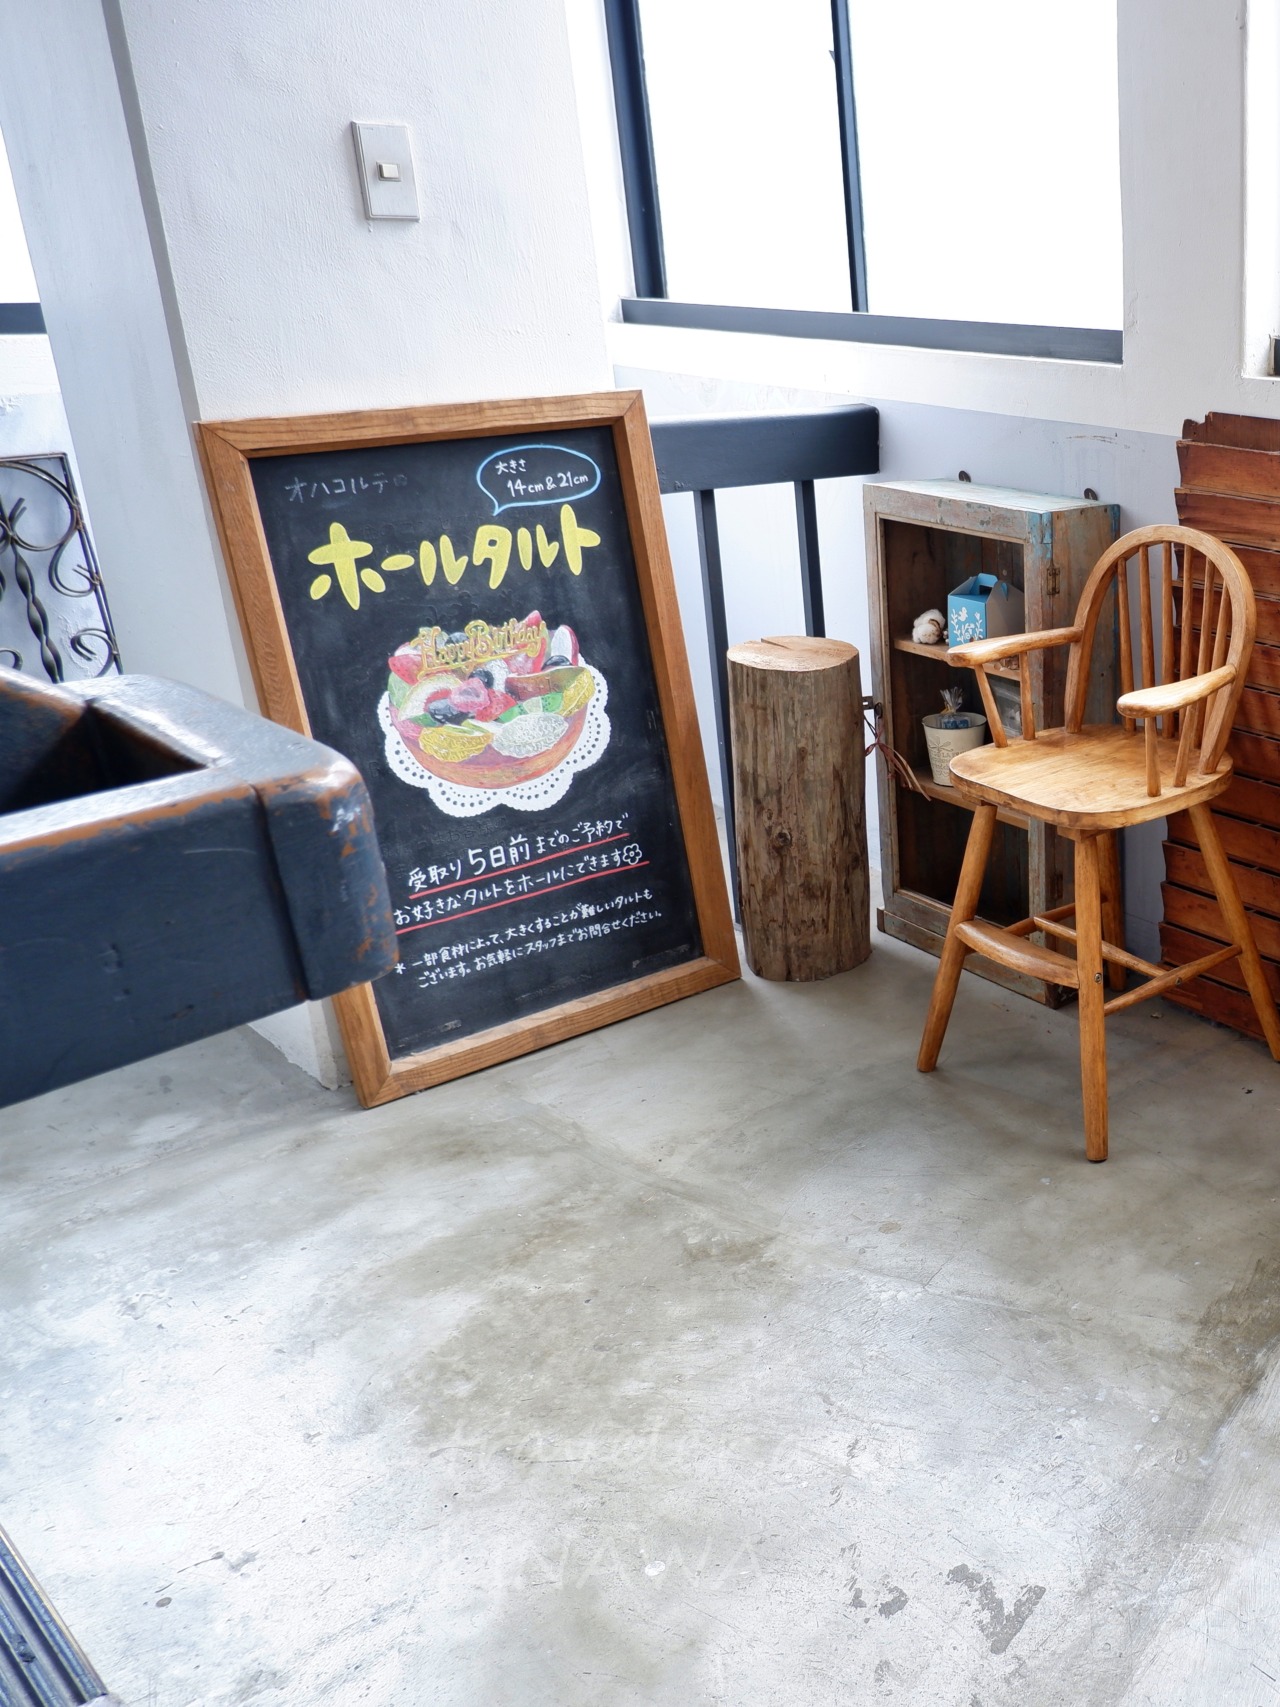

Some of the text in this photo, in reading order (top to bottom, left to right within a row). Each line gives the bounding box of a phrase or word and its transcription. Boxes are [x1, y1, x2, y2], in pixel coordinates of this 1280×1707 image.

[494, 458, 527, 476] 大きさ
[308, 503, 601, 610] ホールタルト
[408, 813, 630, 893] 受取り5日前までのご予約で
